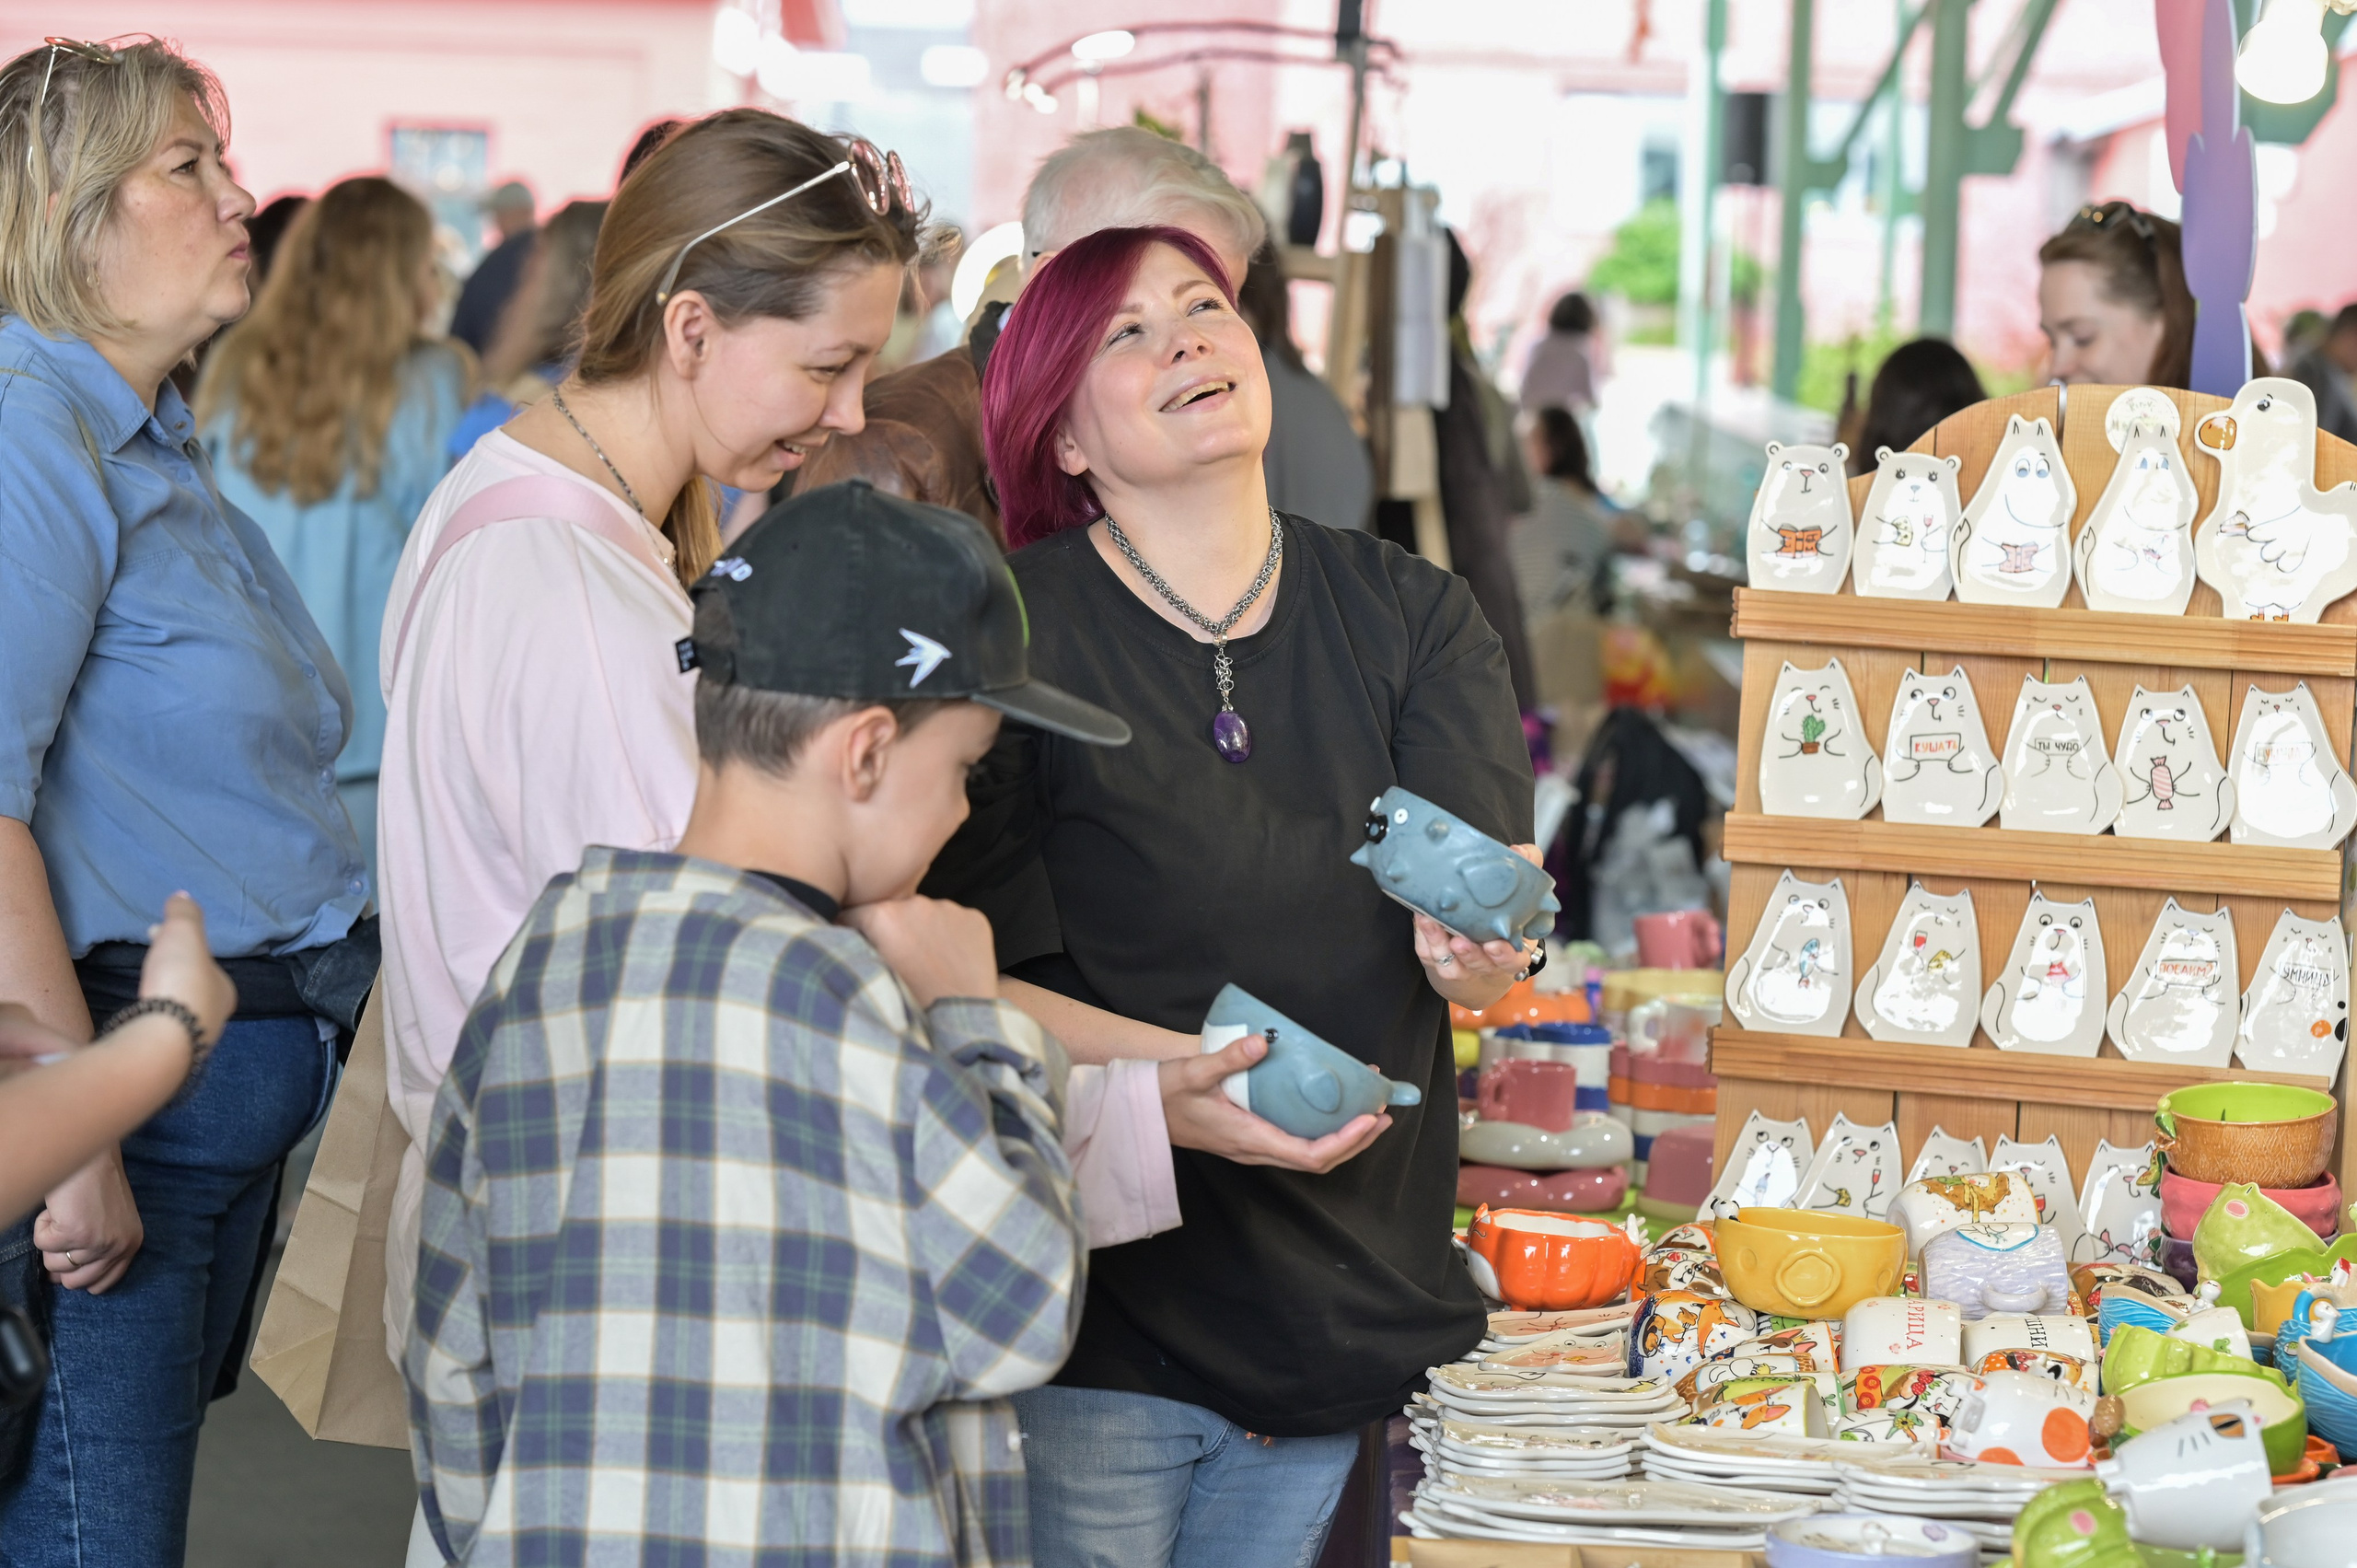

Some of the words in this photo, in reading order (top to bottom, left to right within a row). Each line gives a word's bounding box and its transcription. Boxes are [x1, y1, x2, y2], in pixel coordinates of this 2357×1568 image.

[1915, 739, 1958, 753] КУШАТЬ
[2038, 741, 2050, 750] ТЫ
[2054, 741, 2080, 751] ЧУДО
[1905, 1297, 1925, 1350] АРИЦА
